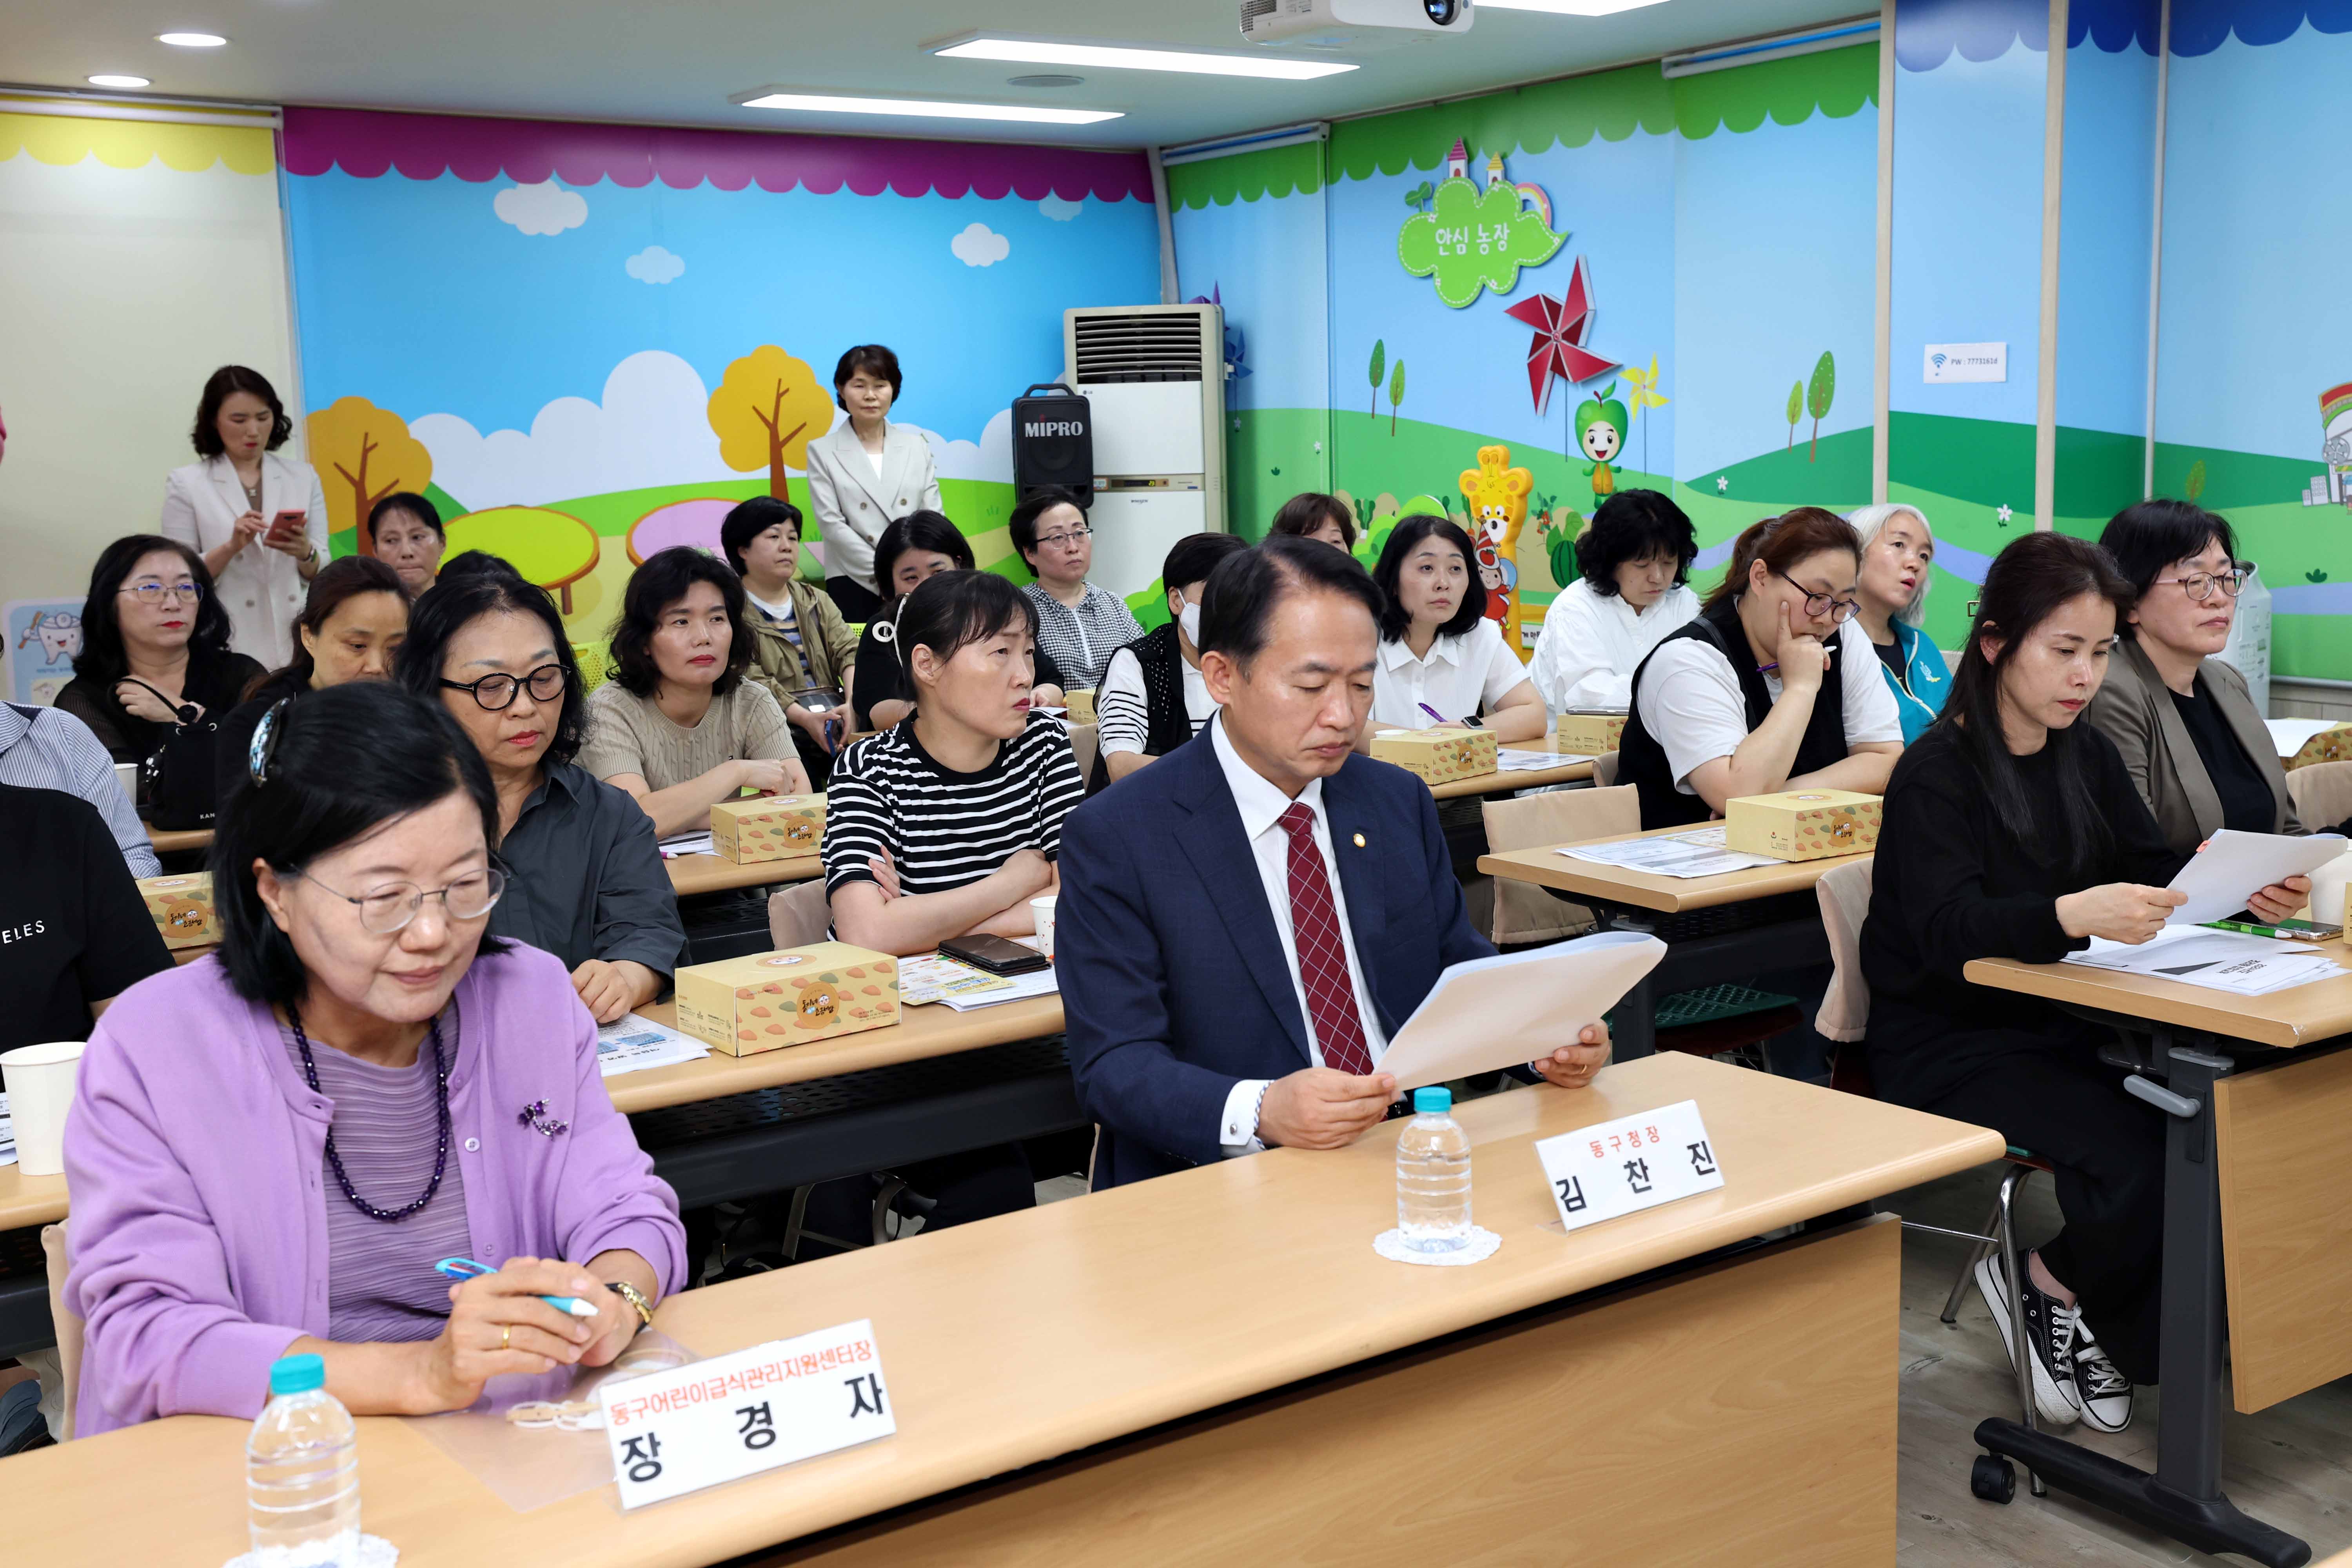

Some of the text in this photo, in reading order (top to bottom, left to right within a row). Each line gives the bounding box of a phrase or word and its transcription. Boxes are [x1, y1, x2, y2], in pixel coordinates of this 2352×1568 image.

[1435, 222, 1510, 256] 안심 농장
[1025, 415, 1083, 437] MIPRO
[1589, 1125, 1660, 1158] 동구청장
[610, 1339, 872, 1426] 동구어린이급식관리지원센터장
